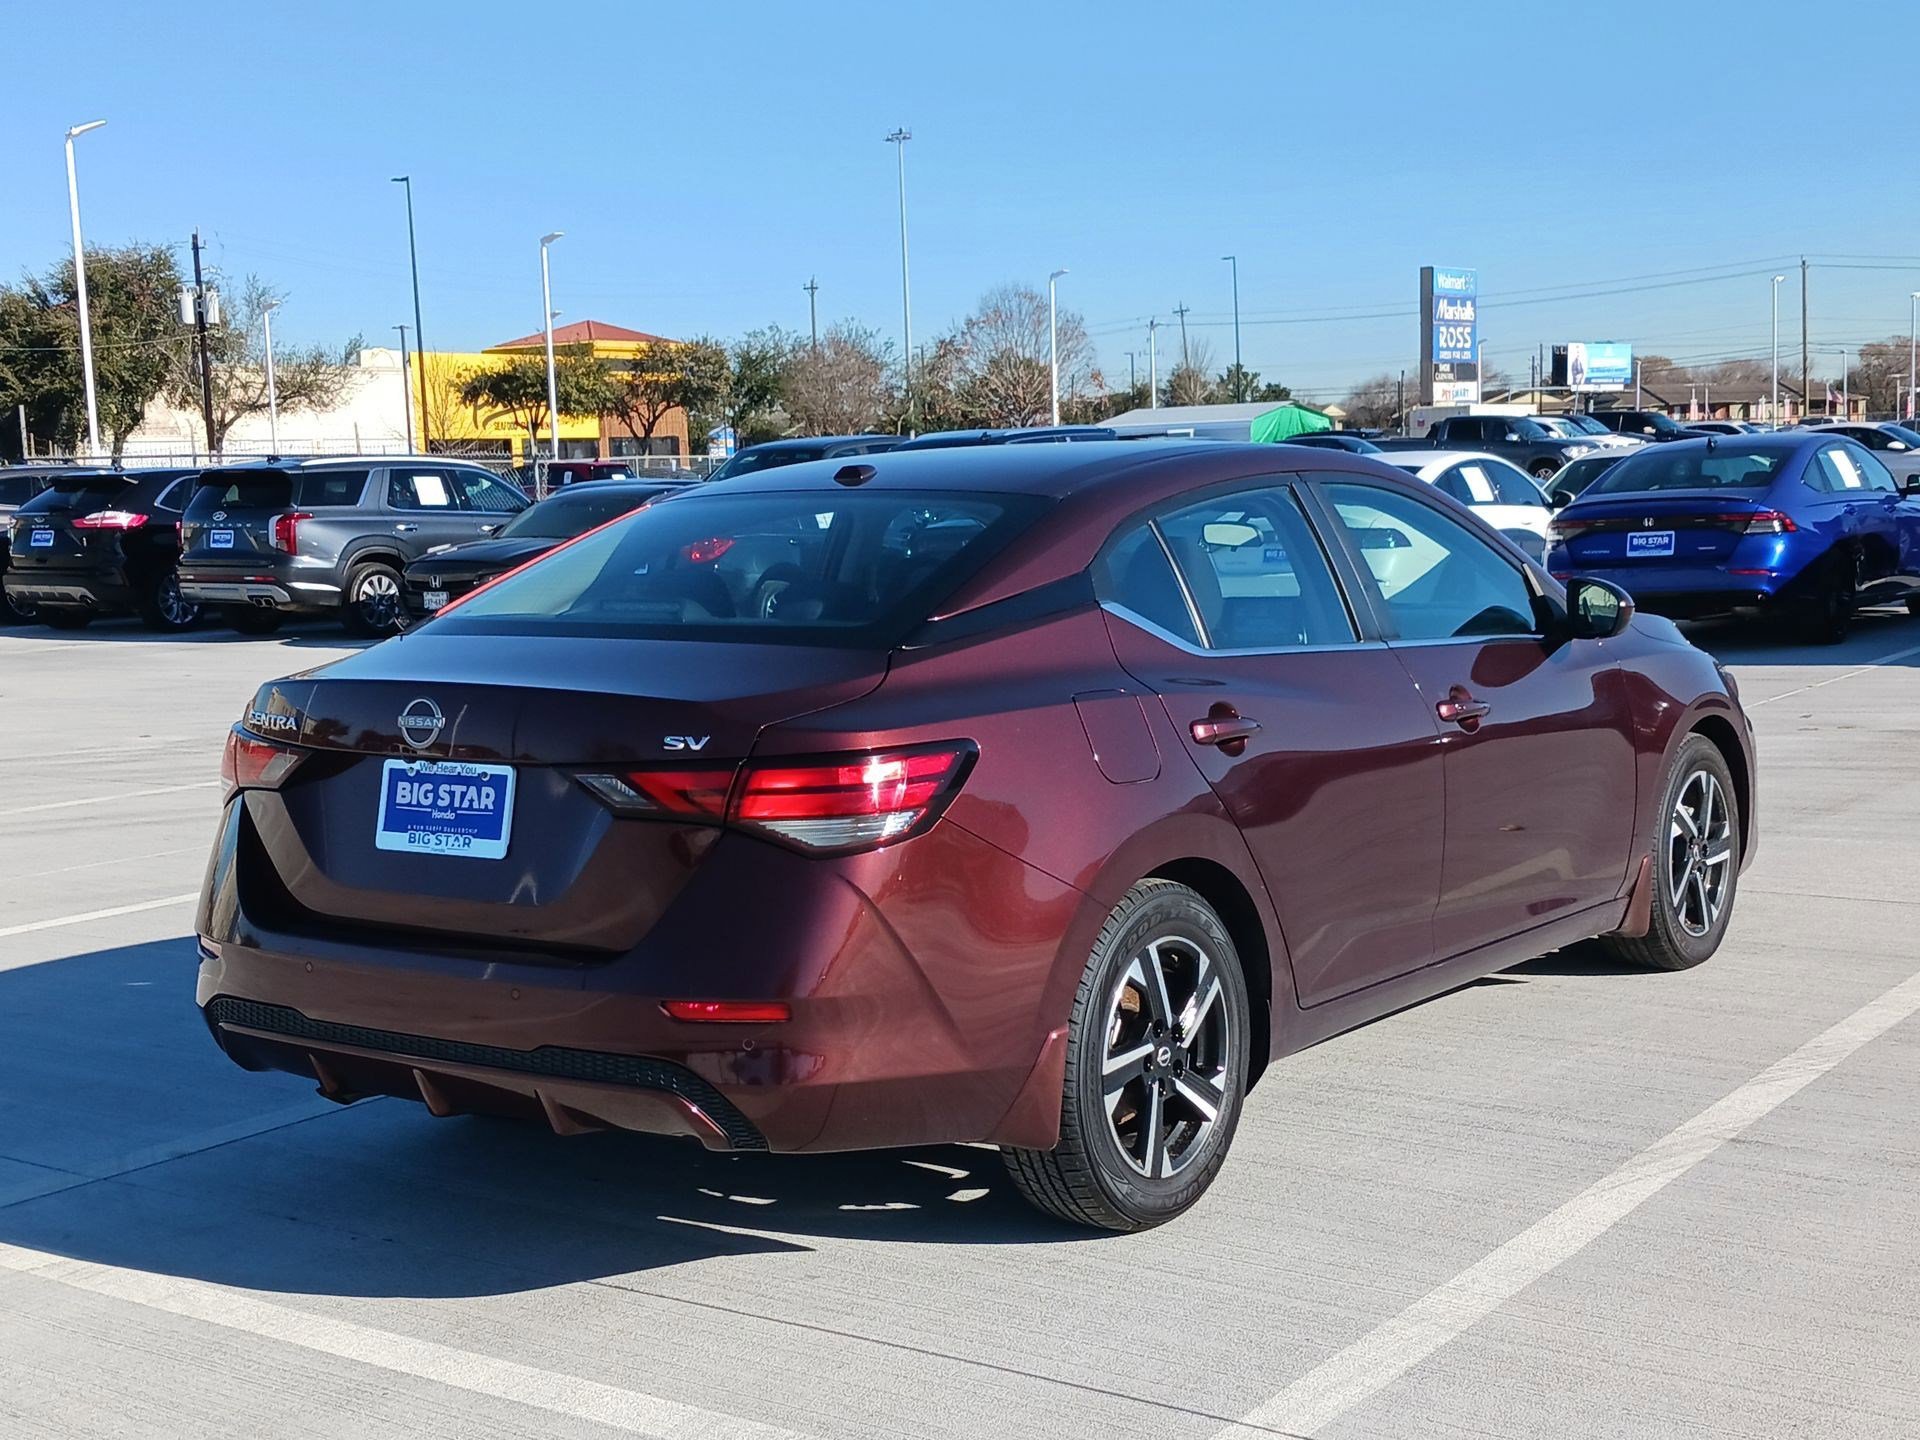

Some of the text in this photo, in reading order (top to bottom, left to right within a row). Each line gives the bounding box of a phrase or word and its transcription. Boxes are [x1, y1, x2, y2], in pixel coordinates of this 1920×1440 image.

[1437, 272, 1467, 291] Walmart
[1436, 299, 1475, 321] Marshalls
[1439, 327, 1472, 349] ROSS
[1632, 538, 1647, 546] BIG
[1647, 536, 1669, 545] STAR
[249, 711, 298, 731] SENTRA
[398, 715, 446, 728] NISSAN
[663, 735, 711, 750] SV
[420, 763, 478, 775] We Hear You
[395, 781, 496, 809] BIG STAR
[431, 809, 456, 820] Honda
[408, 833, 472, 849] BIG STAR
